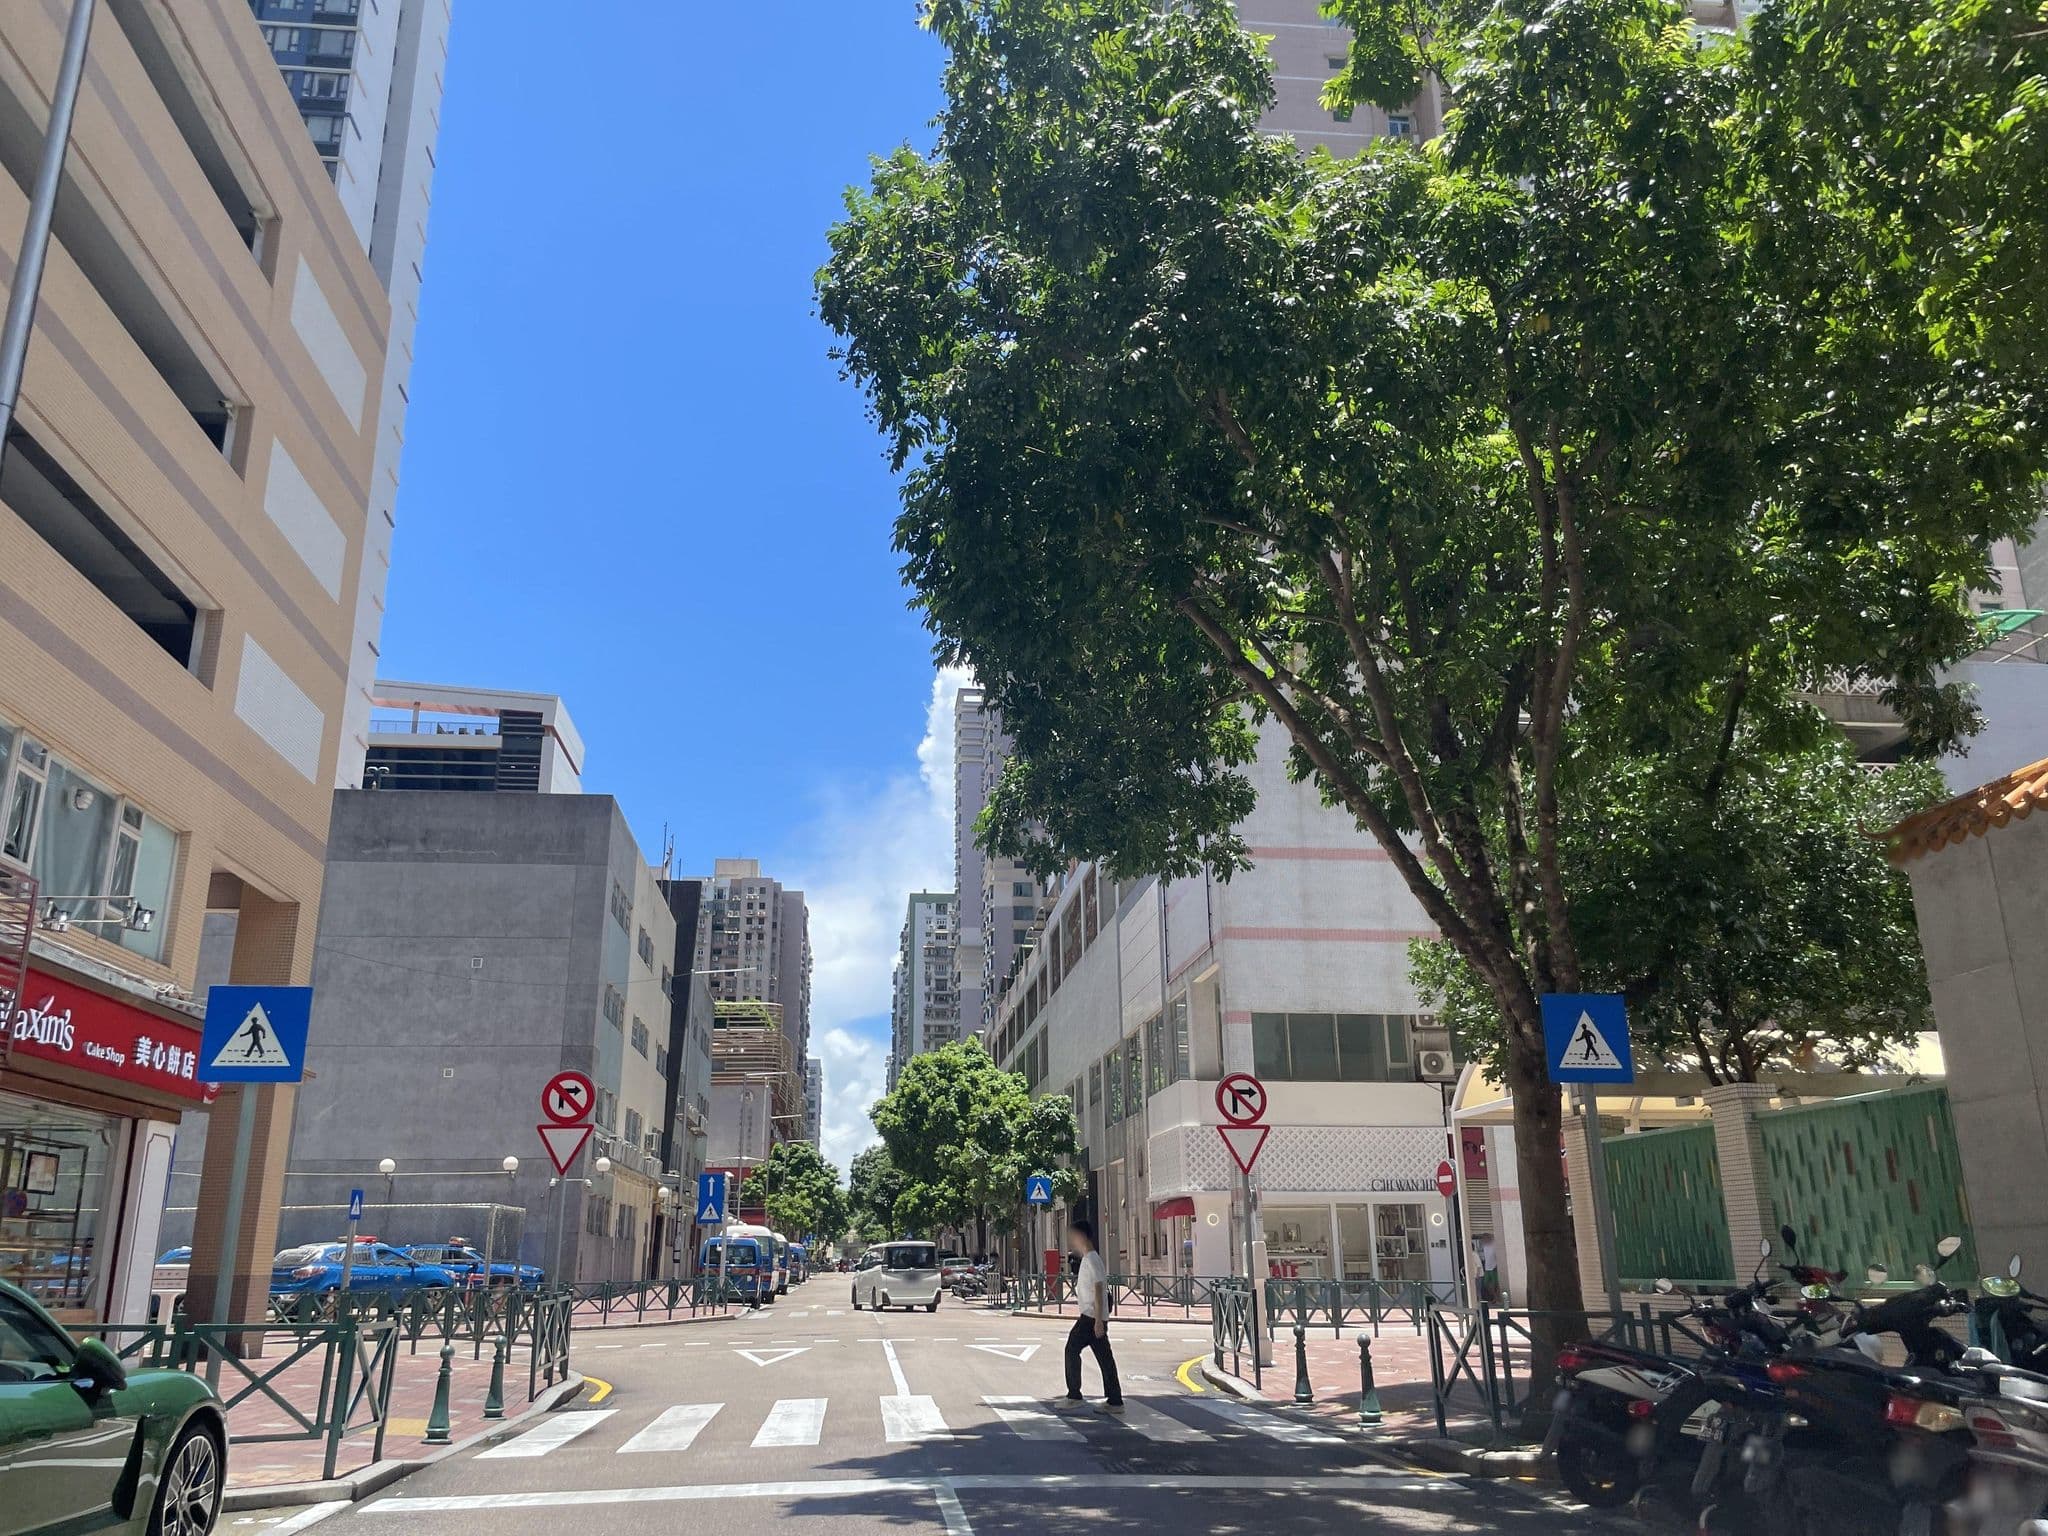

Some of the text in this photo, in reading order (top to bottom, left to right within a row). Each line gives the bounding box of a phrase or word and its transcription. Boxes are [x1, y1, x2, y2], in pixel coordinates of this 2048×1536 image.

[86, 1041, 105, 1060] Cake
[106, 1046, 125, 1067] Shop
[135, 1036, 196, 1080] 美心餅店
